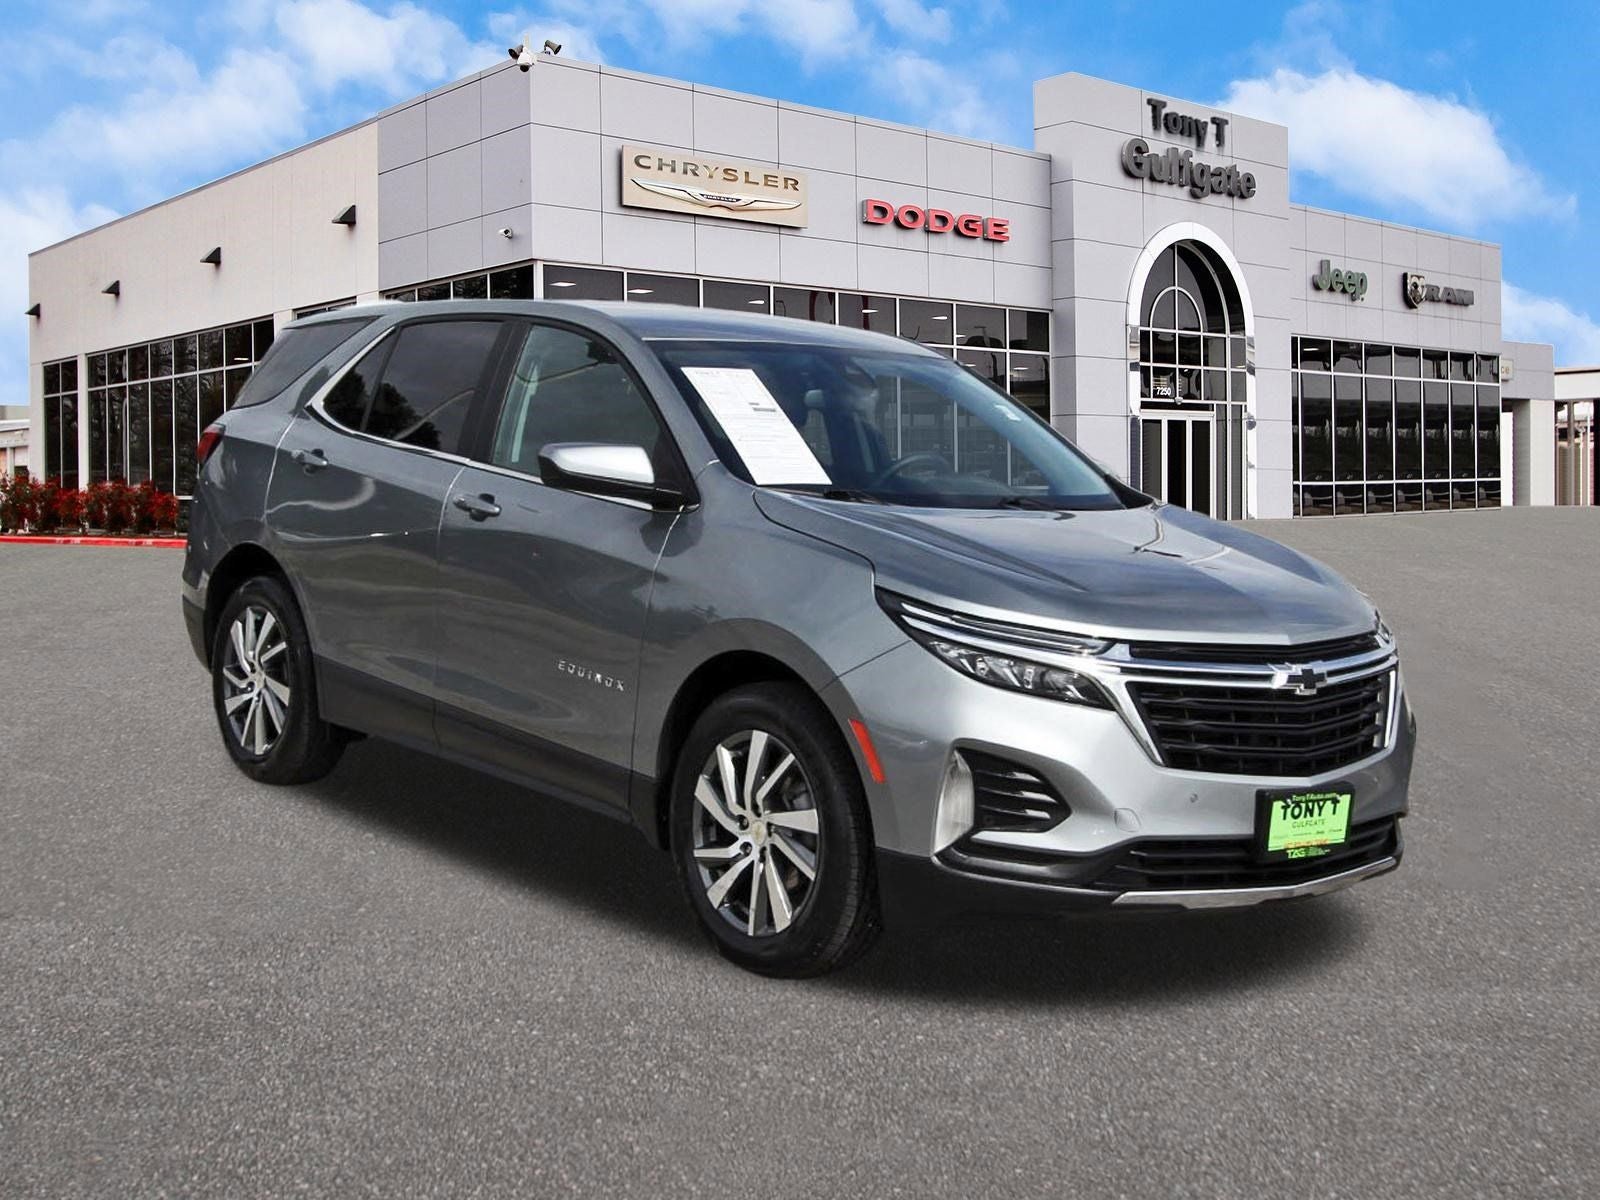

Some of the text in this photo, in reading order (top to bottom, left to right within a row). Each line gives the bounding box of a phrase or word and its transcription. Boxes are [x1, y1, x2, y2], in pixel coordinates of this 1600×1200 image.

[1147, 98, 1229, 148] Tony T
[633, 154, 800, 192] CHRYSLER
[1121, 138, 1257, 199] Gulfgate
[862, 199, 1011, 242] DODGE
[1313, 259, 1368, 301] Jeep
[1425, 284, 1475, 307] RAM
[1156, 387, 1172, 396] 7250
[1281, 798, 1340, 820] TONY T
